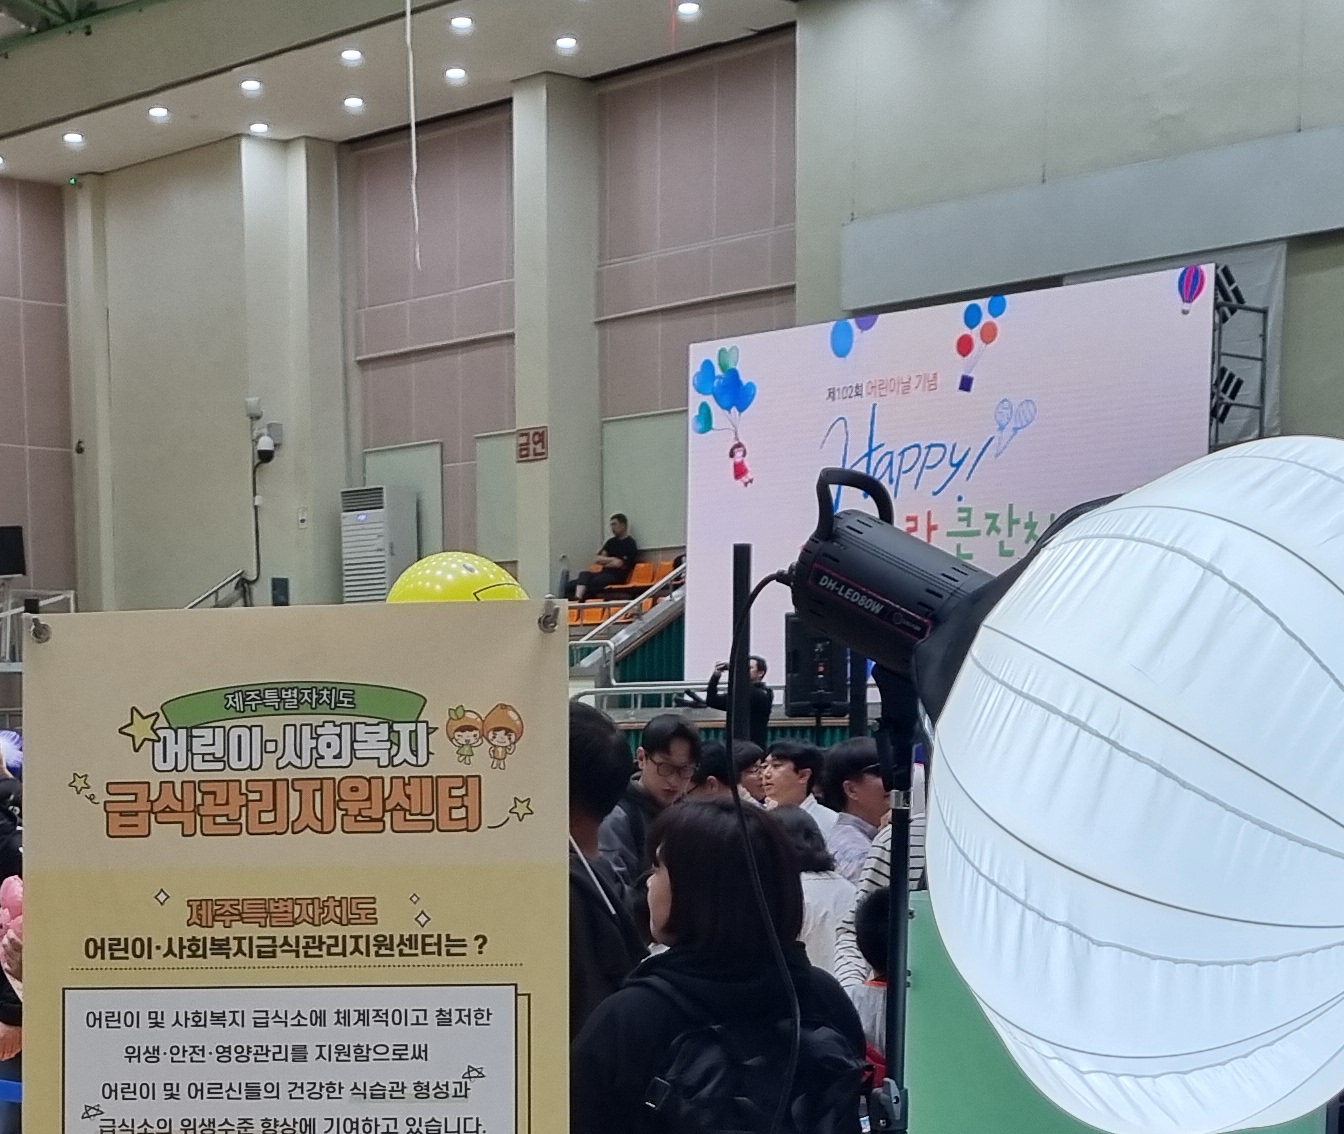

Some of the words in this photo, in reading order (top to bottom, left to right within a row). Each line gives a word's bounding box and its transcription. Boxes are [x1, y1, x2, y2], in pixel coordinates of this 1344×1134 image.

[826, 382, 863, 401] 제102회
[865, 376, 911, 398] 어린이날
[915, 372, 938, 393] 기념
[518, 430, 546, 458] 금연
[819, 403, 996, 512] Happy!
[819, 575, 885, 614] DH-LED80W
[225, 687, 356, 710] 제주특별자치도
[153, 721, 429, 773] 어린이·사회복지
[103, 775, 482, 838] 급식관리지원센터
[186, 896, 378, 927] 제주특별자치도
[85, 1009, 141, 1029] 어린이
[147, 1009, 166, 1029] 및
[171, 1009, 246, 1029] 사회복지
[251, 1008, 327, 1029] 급식소에
[333, 1007, 429, 1027] 체계적이고
[434, 1007, 493, 1027] 철저한
[314, 1043, 429, 1064] 지원함으로써
[101, 1080, 157, 1101] 어린이
[163, 1080, 181, 1101] 및
[187, 1080, 281, 1101] 어르신들의
[287, 1080, 344, 1101] 건강한
[349, 1080, 407, 1101] 식습관
[412, 1080, 472, 1101] 형성과
